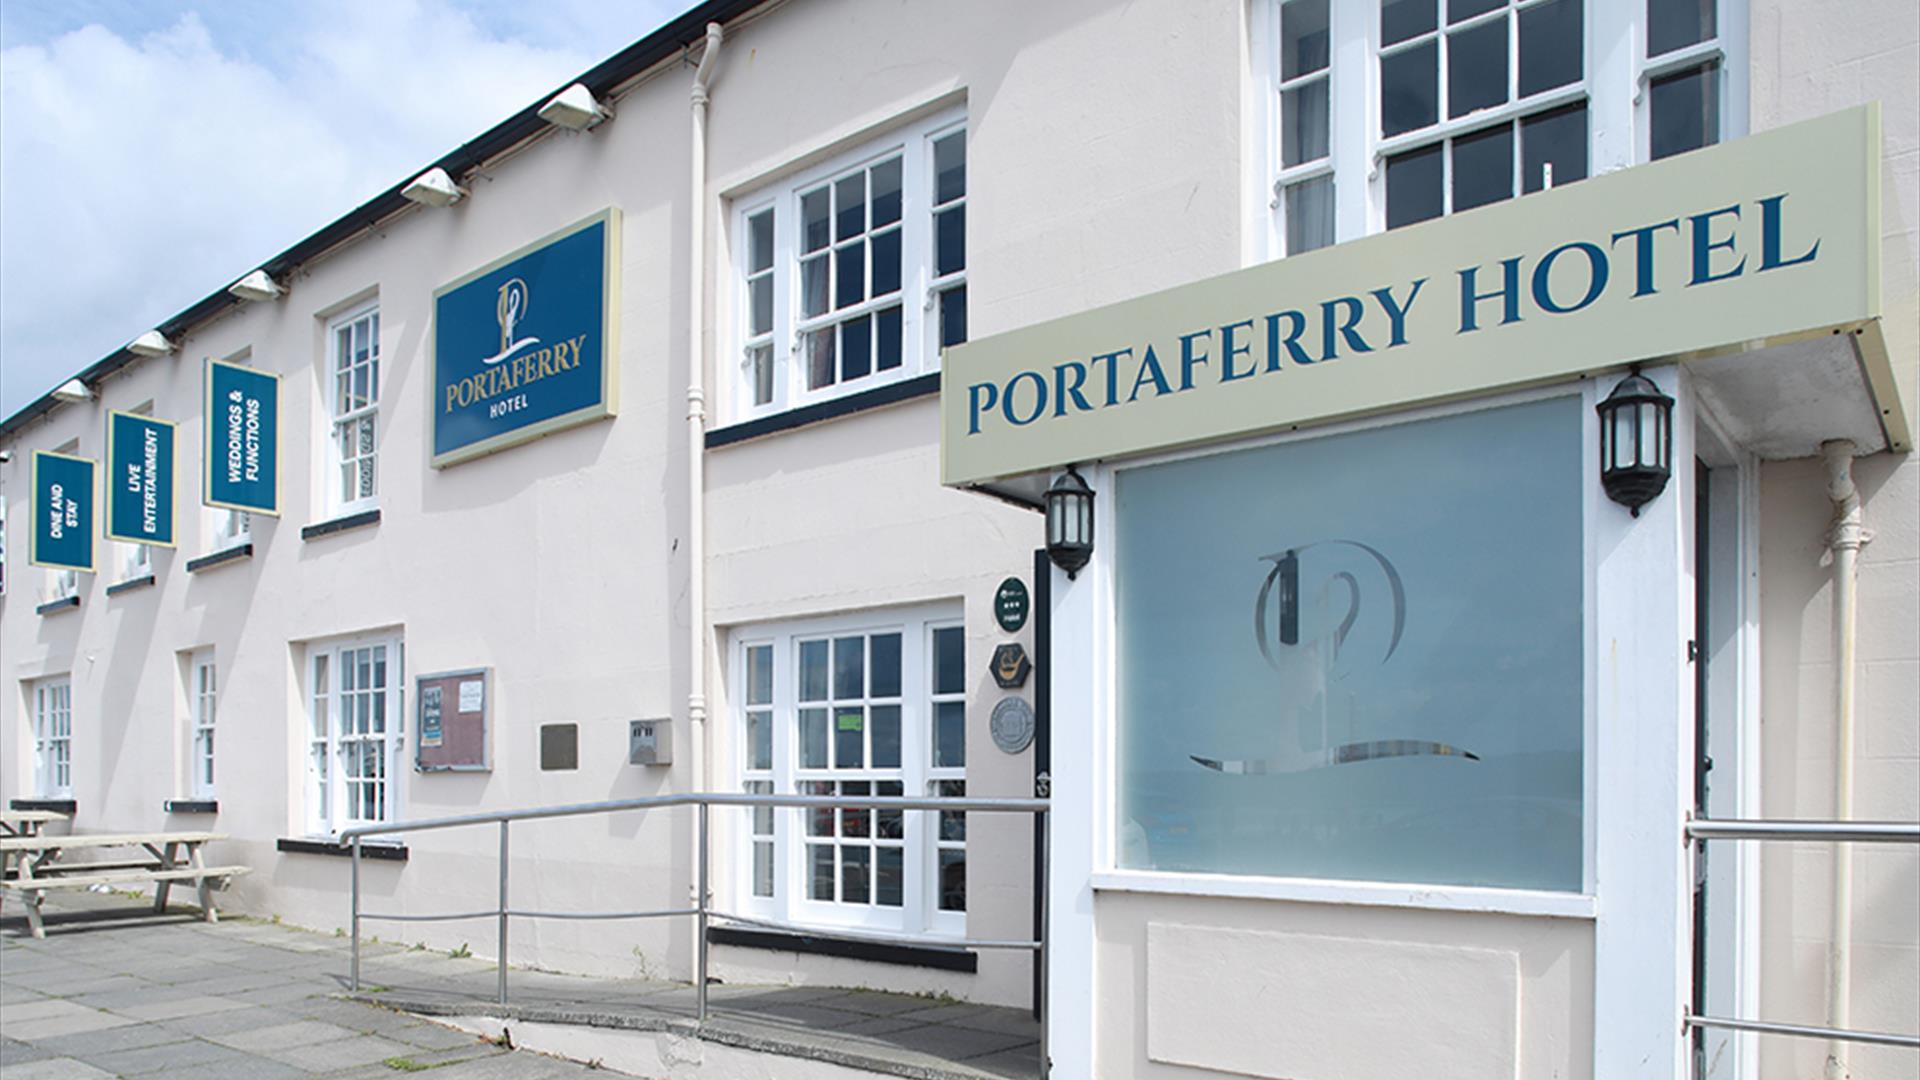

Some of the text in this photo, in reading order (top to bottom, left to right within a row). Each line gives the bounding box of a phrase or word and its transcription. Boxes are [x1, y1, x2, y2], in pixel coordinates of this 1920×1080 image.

[966, 192, 1822, 436] PORTAFERRY HOTEL
[445, 334, 587, 413] PORTAFERRY
[489, 394, 529, 418] HOTEL
[128, 463, 141, 493] LIVE
[228, 405, 243, 483] WEDDINGS
[246, 399, 260, 482] FUNCTIONS
[51, 484, 63, 539] DINE AND
[66, 499, 78, 527] STAY
[144, 428, 158, 534] ENTERTAINMENT
